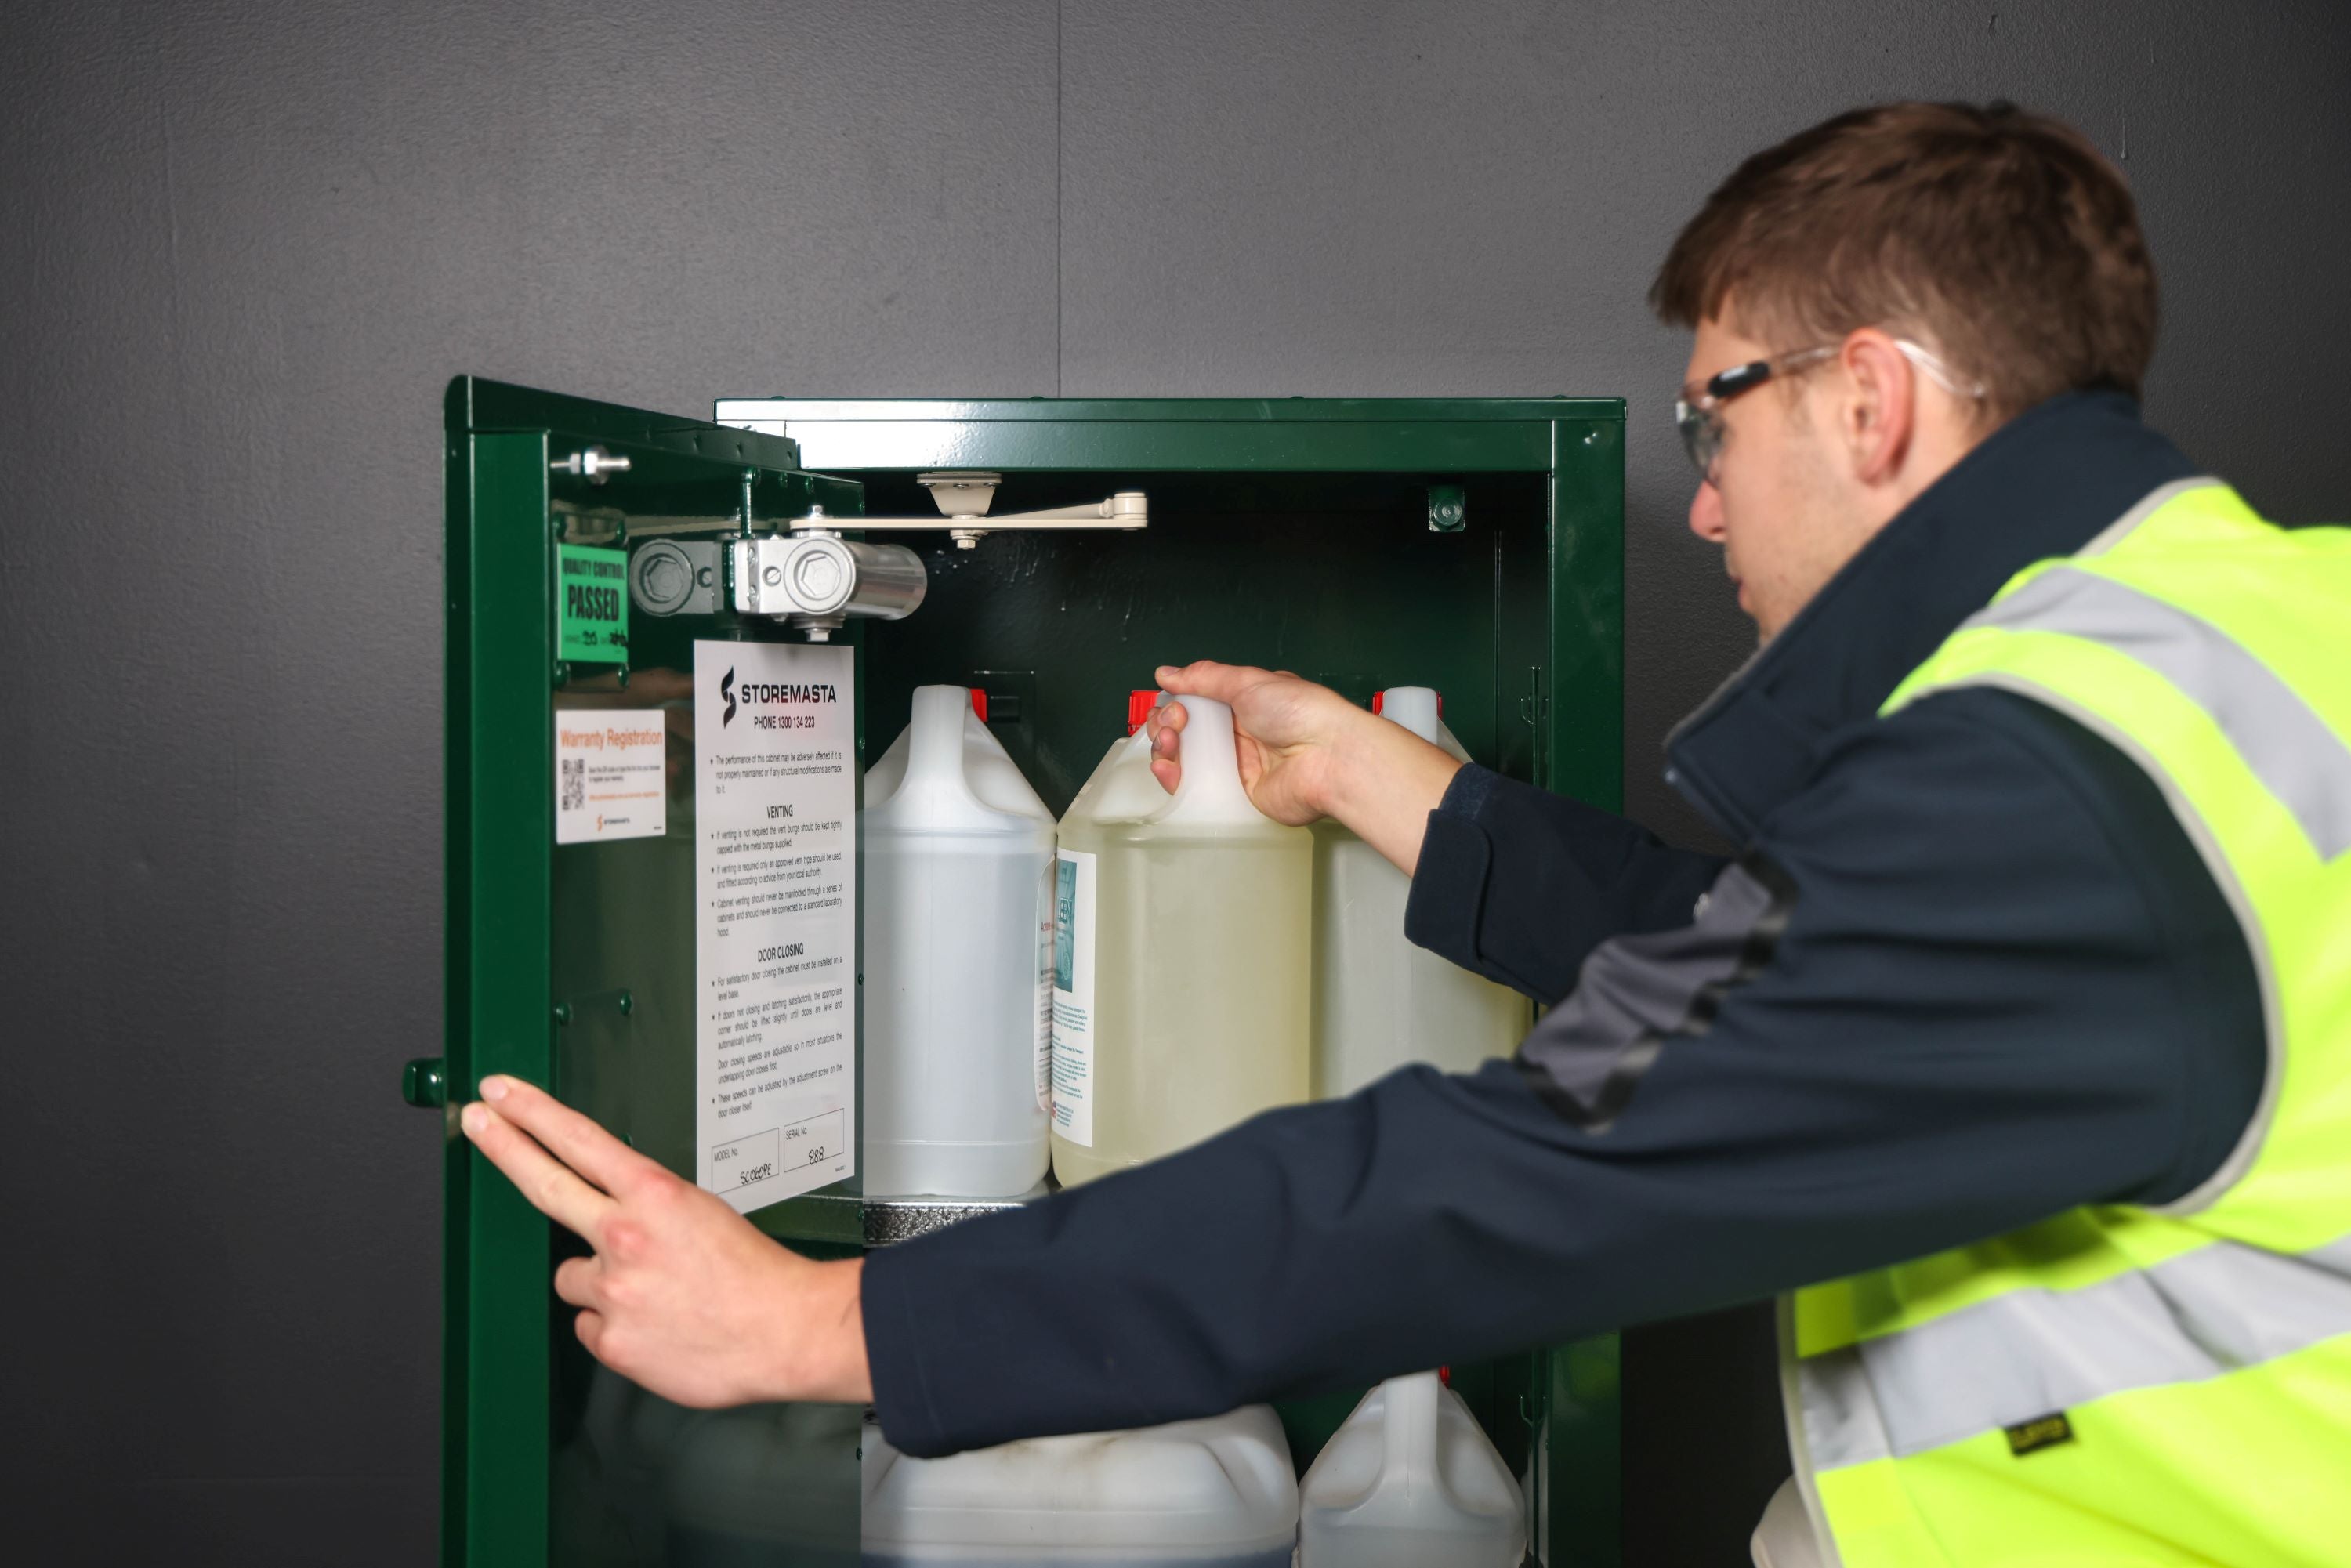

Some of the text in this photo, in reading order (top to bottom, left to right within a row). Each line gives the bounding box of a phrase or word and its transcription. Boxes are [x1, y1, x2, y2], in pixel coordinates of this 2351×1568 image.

[594, 560, 625, 580] CONTROL
[567, 584, 619, 621] PASSED
[741, 684, 836, 703] STOREMASTA
[754, 715, 814, 729] PHONE 1300 134 223
[560, 727, 662, 751] Warranty Registration
[767, 805, 792, 818] VENTING
[758, 943, 803, 961] DOOR CLOSING
[786, 1129, 799, 1139] SERIAL
[714, 1149, 730, 1161] MODEL
